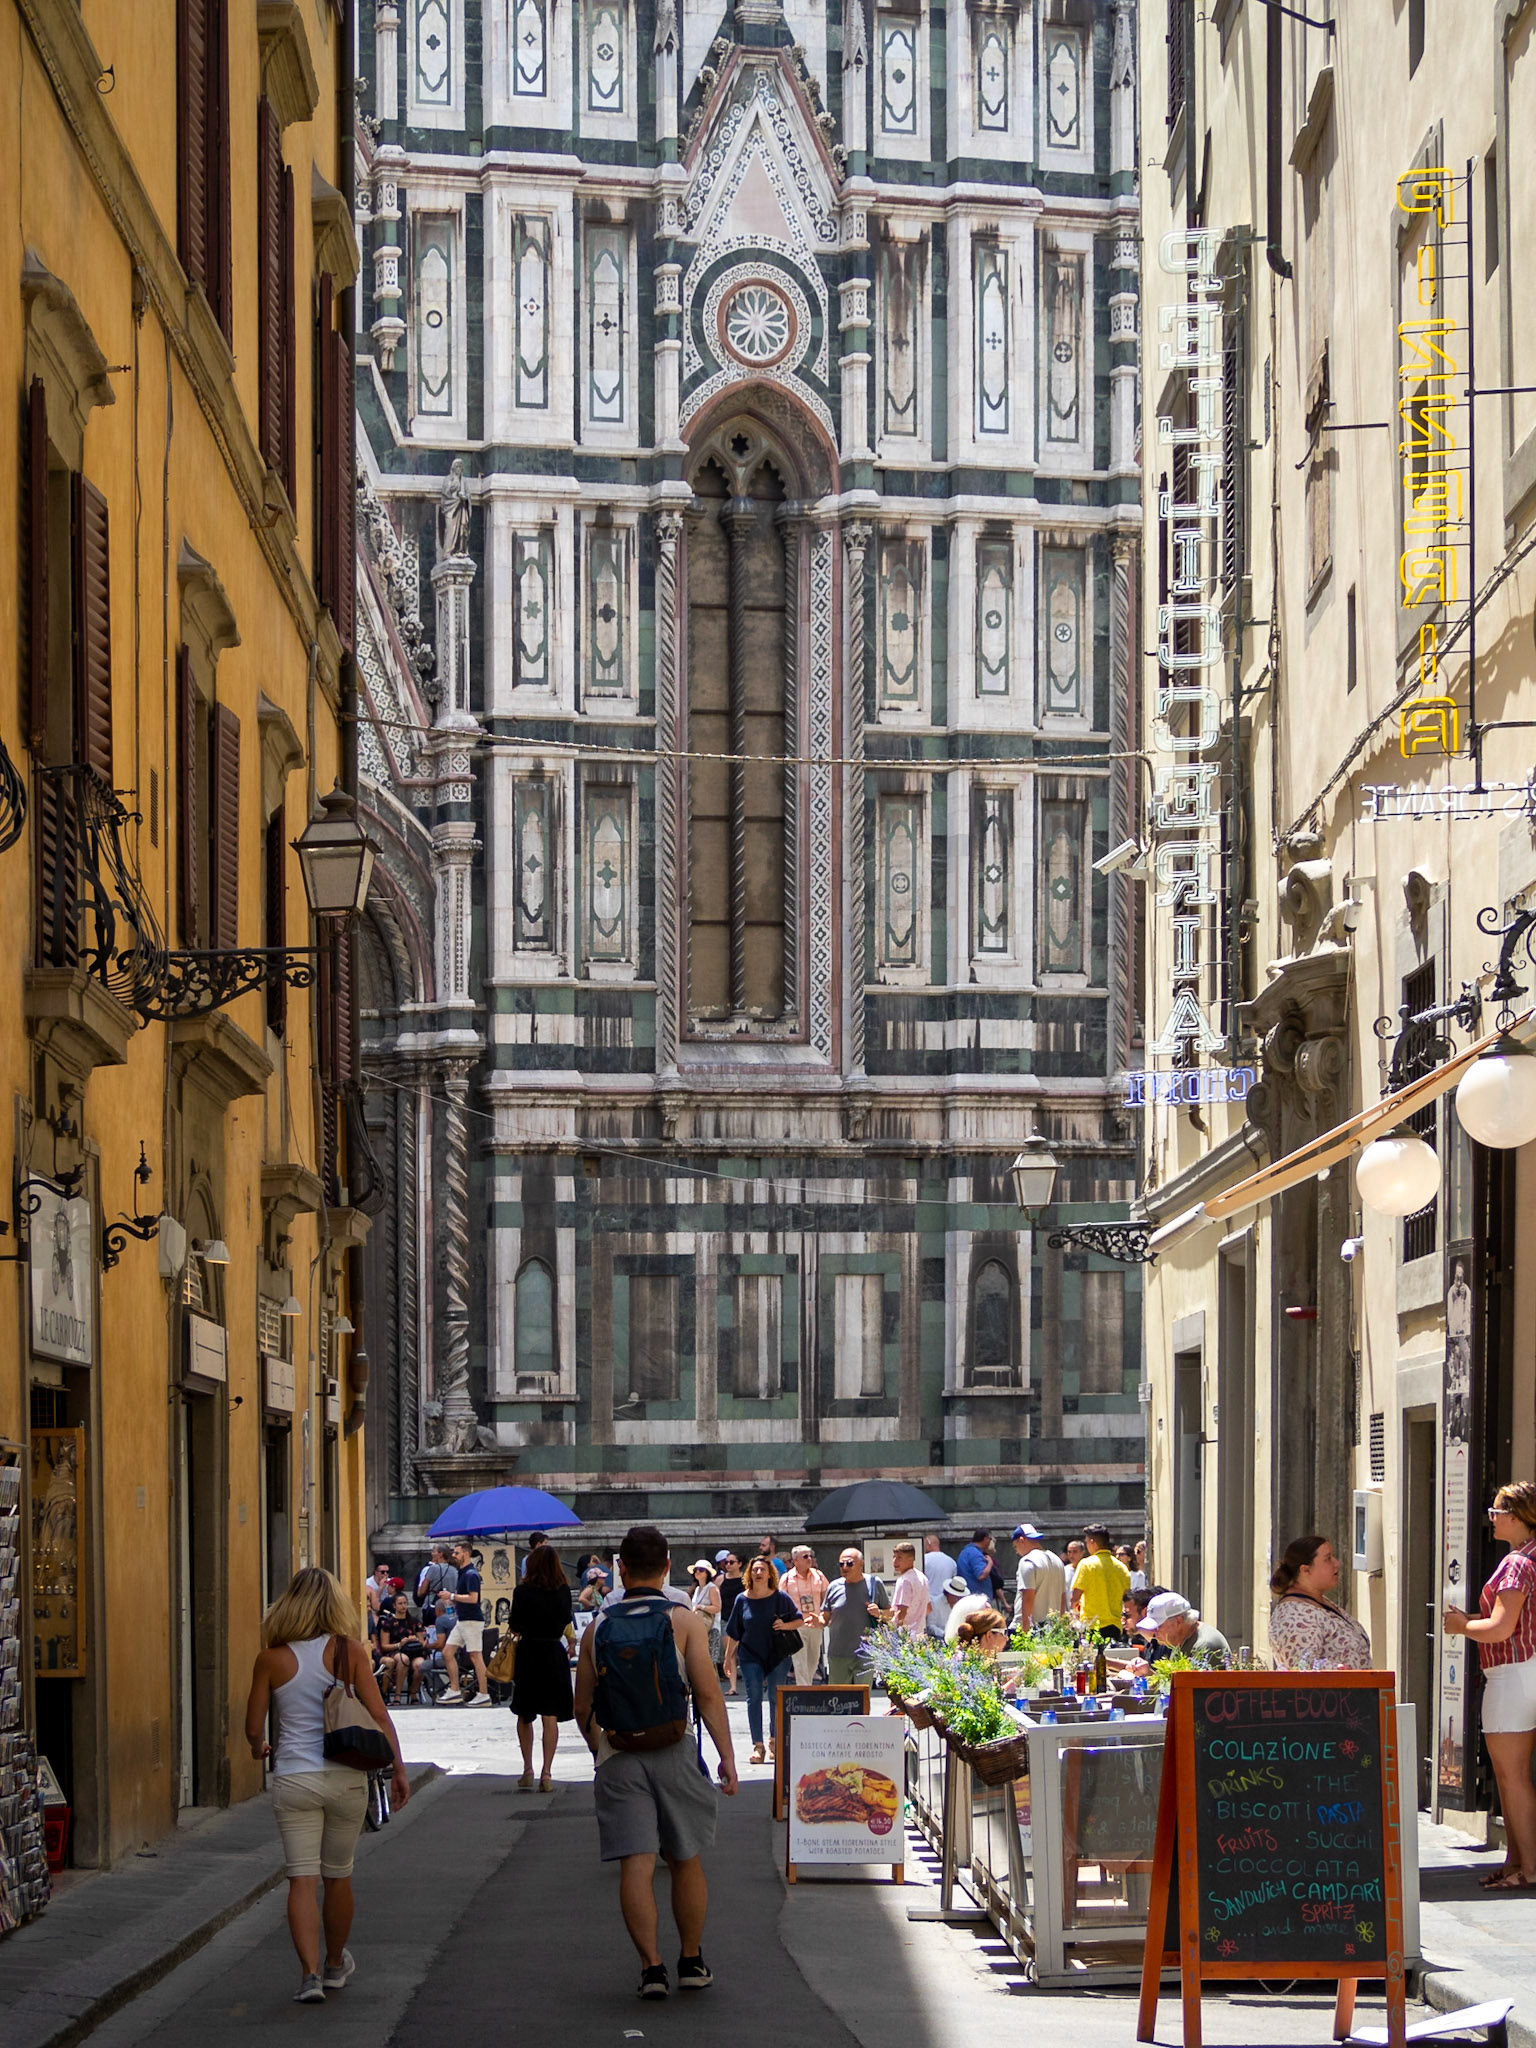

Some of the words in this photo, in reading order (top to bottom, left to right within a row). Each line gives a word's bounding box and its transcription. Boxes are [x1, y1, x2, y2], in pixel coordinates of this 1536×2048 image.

[800, 1742, 832, 1750] BISTECCA
[836, 1742, 851, 1750] ALLA
[855, 1742, 895, 1750] FIORENTINA
[811, 1750, 826, 1758] CON
[828, 1750, 851, 1758] PATATE
[854, 1750, 884, 1758] ARROSTO
[1209, 1736, 1337, 1761] COLAZIONE
[1207, 1766, 1284, 1799] DRINKS
[1316, 1801, 1366, 1826] PASTA
[841, 1838, 878, 1847] FIORENTINA
[880, 1838, 897, 1847] STYLE
[1216, 1827, 1278, 1854] FRUITS
[1305, 1829, 1373, 1849] SUCCHI
[854, 1847, 885, 1855] POTATOES
[1216, 1857, 1360, 1878] CIOCCOLATA
[1292, 1877, 1382, 1907] CAMPARI
[1301, 1901, 1355, 1923] SPRITZ
[1262, 1917, 1295, 1937] and
